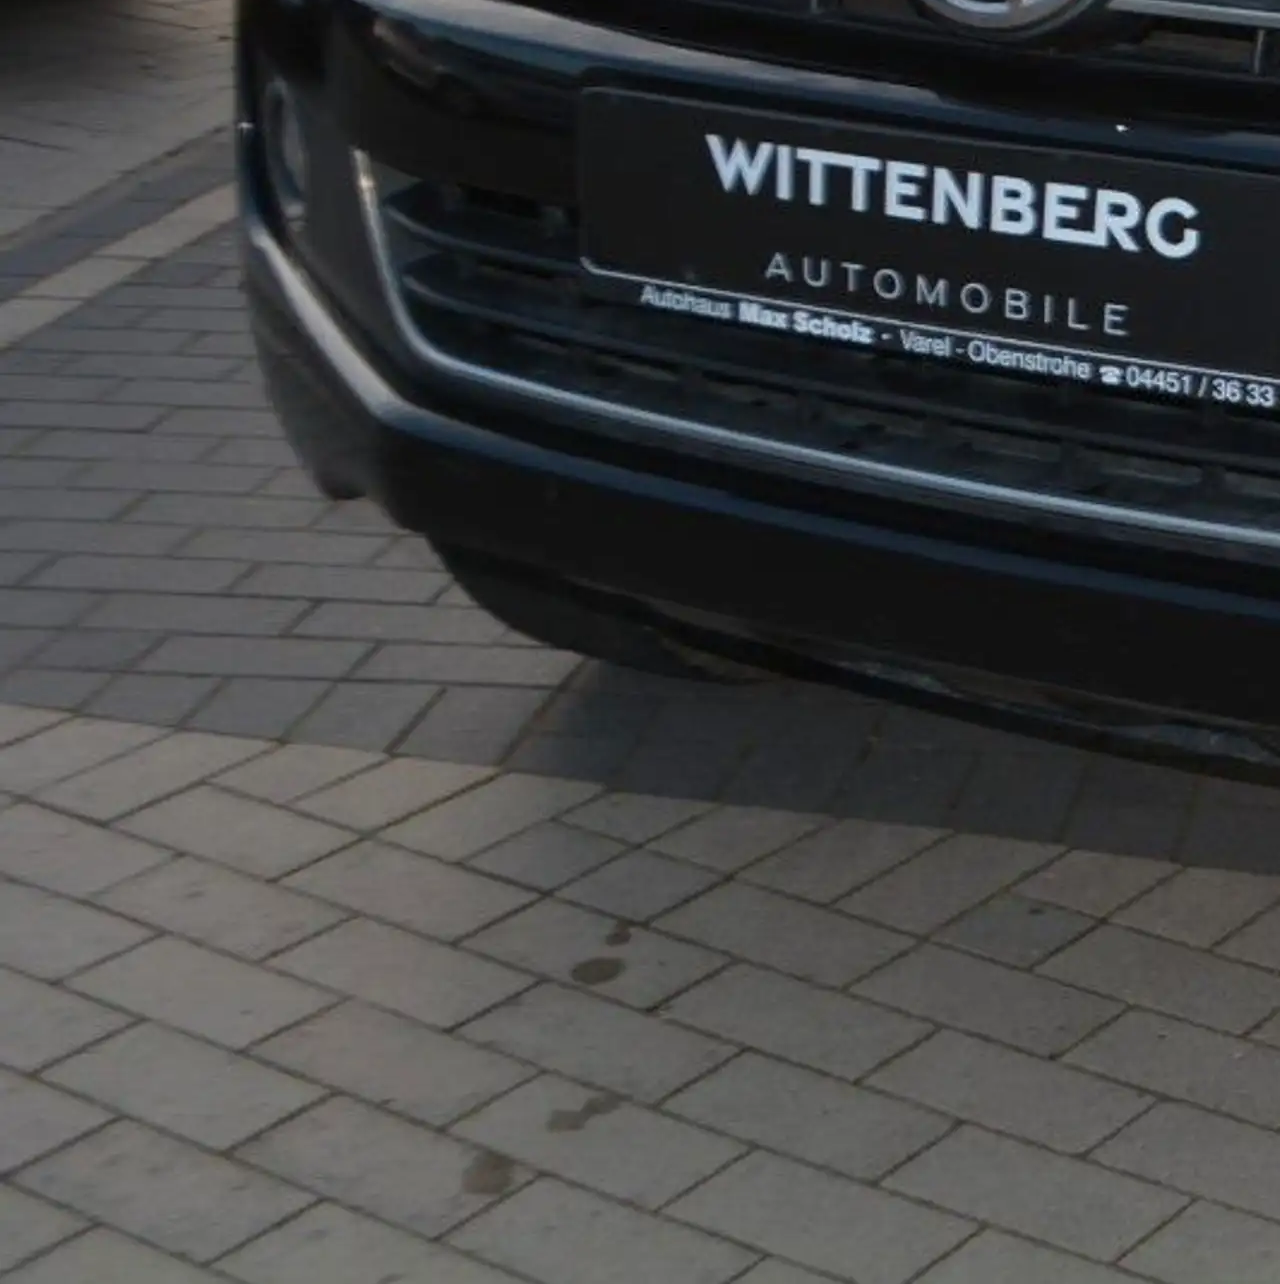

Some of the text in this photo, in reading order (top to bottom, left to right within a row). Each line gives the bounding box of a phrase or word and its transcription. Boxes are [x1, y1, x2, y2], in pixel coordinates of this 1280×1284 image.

[705, 133, 1200, 259] WITTENBERG
[640, 284, 732, 320] Autohaus
[737, 299, 789, 330] Max
[792, 311, 874, 344] Scholz
[900, 328, 952, 357] Varel
[967, 340, 1092, 380] Obenstrohe
[1124, 366, 1191, 395] 04451
[1211, 377, 1242, 403] 36
[1244, 382, 1276, 408] 33
[764, 251, 1130, 337] AUTOMOBILE
